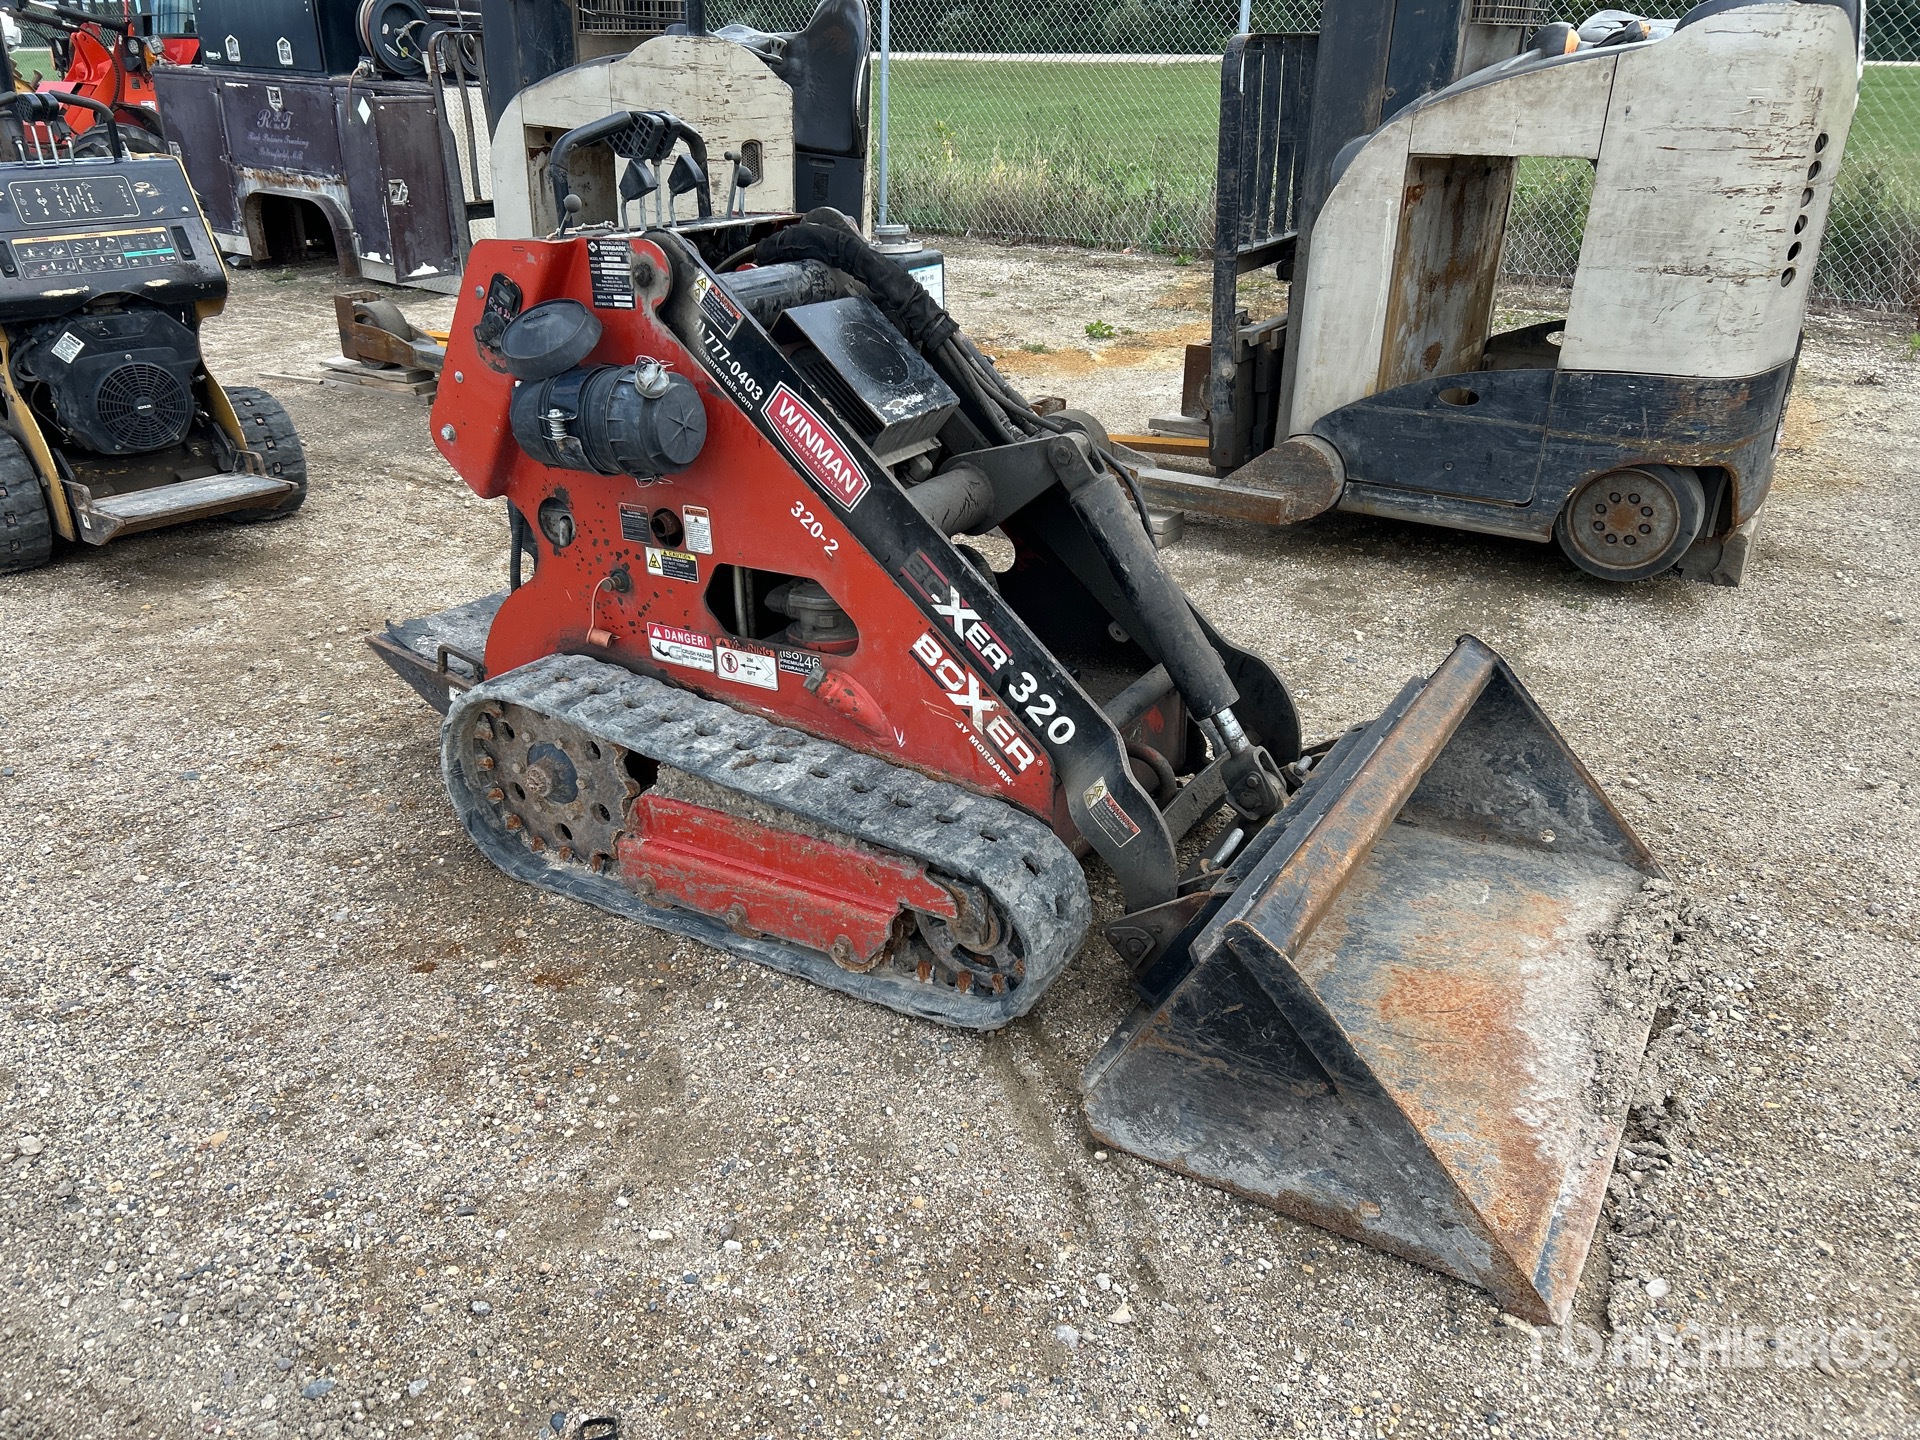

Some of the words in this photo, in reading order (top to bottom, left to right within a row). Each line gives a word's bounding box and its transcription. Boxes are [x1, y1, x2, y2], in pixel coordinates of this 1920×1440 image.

[704, 330, 764, 400] 777-0403
[779, 397, 858, 493] WINMAN
[781, 424, 813, 460] EQUIPMENT
[814, 461, 837, 488] RENTALS
[790, 500, 839, 556] 320-2
[664, 628, 708, 648] DANGER!
[780, 650, 802, 662] (ISO)
[804, 656, 820, 668] 46
[912, 632, 1035, 772] BOXER
[1008, 671, 1076, 744] 320
[968, 734, 1014, 786] MORBARK
